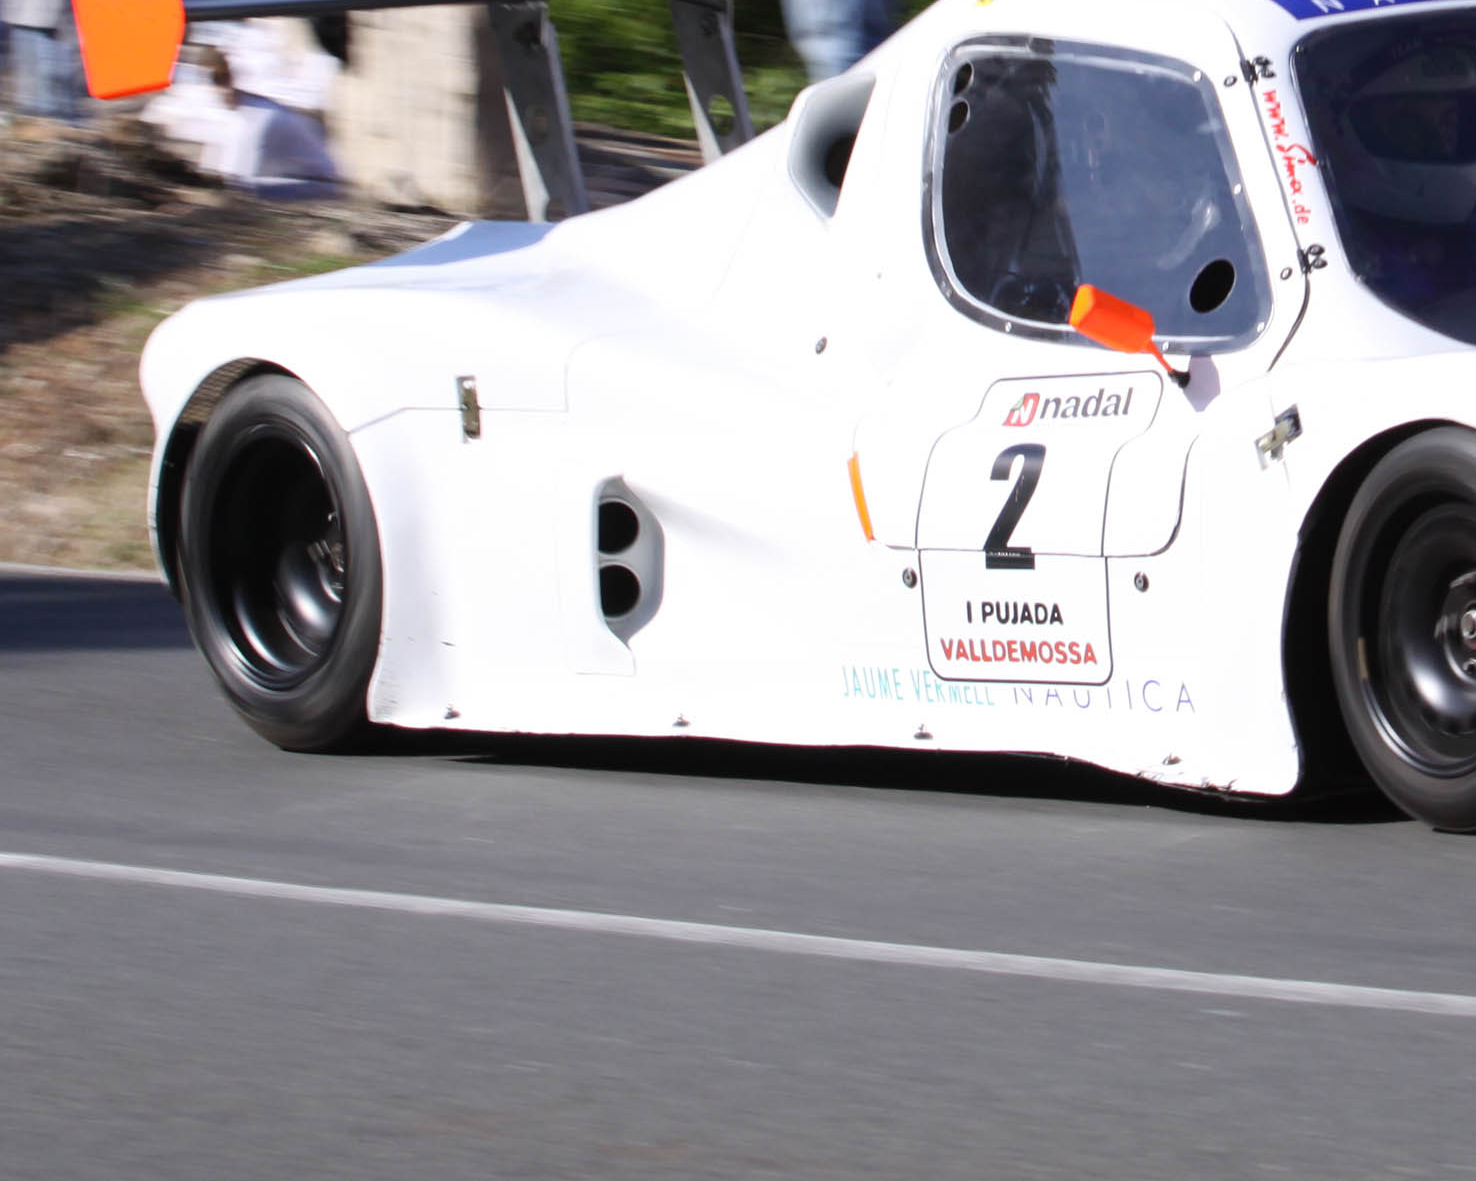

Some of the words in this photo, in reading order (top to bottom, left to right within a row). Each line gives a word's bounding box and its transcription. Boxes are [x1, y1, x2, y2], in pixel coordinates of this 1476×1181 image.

[1040, 387, 1133, 420] nadal
[983, 442, 1046, 569] 2
[966, 600, 973, 624] I
[981, 601, 1064, 625] PUJADA
[940, 638, 1098, 665] VALLDEMOSSA
[842, 665, 904, 701] JAUME
